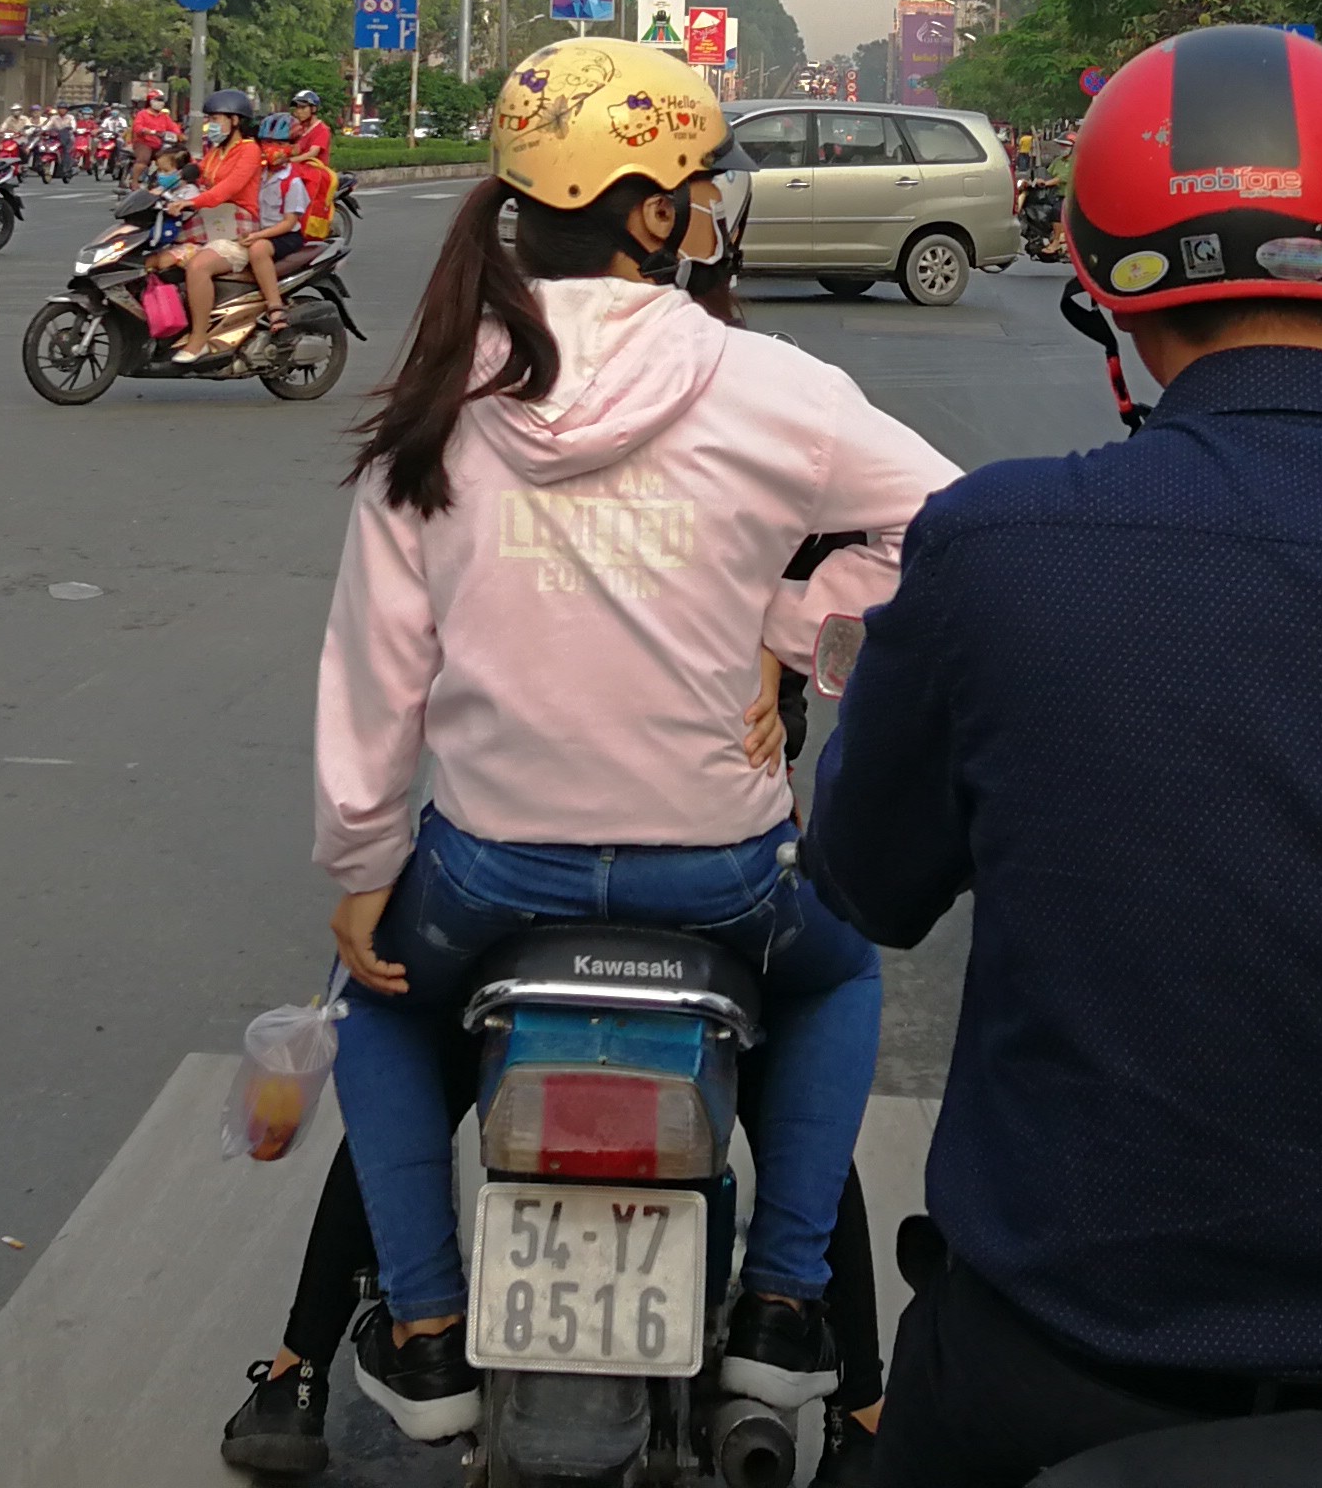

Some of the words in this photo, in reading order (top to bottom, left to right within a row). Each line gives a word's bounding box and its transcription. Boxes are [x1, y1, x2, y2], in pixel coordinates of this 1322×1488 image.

[667, 95, 696, 110] Hello
[1169, 167, 1302, 195] mobifone
[574, 955, 683, 979] Kawasaki
[509, 1198, 671, 1275] 54-Y7
[502, 1281, 668, 1357] 8516
